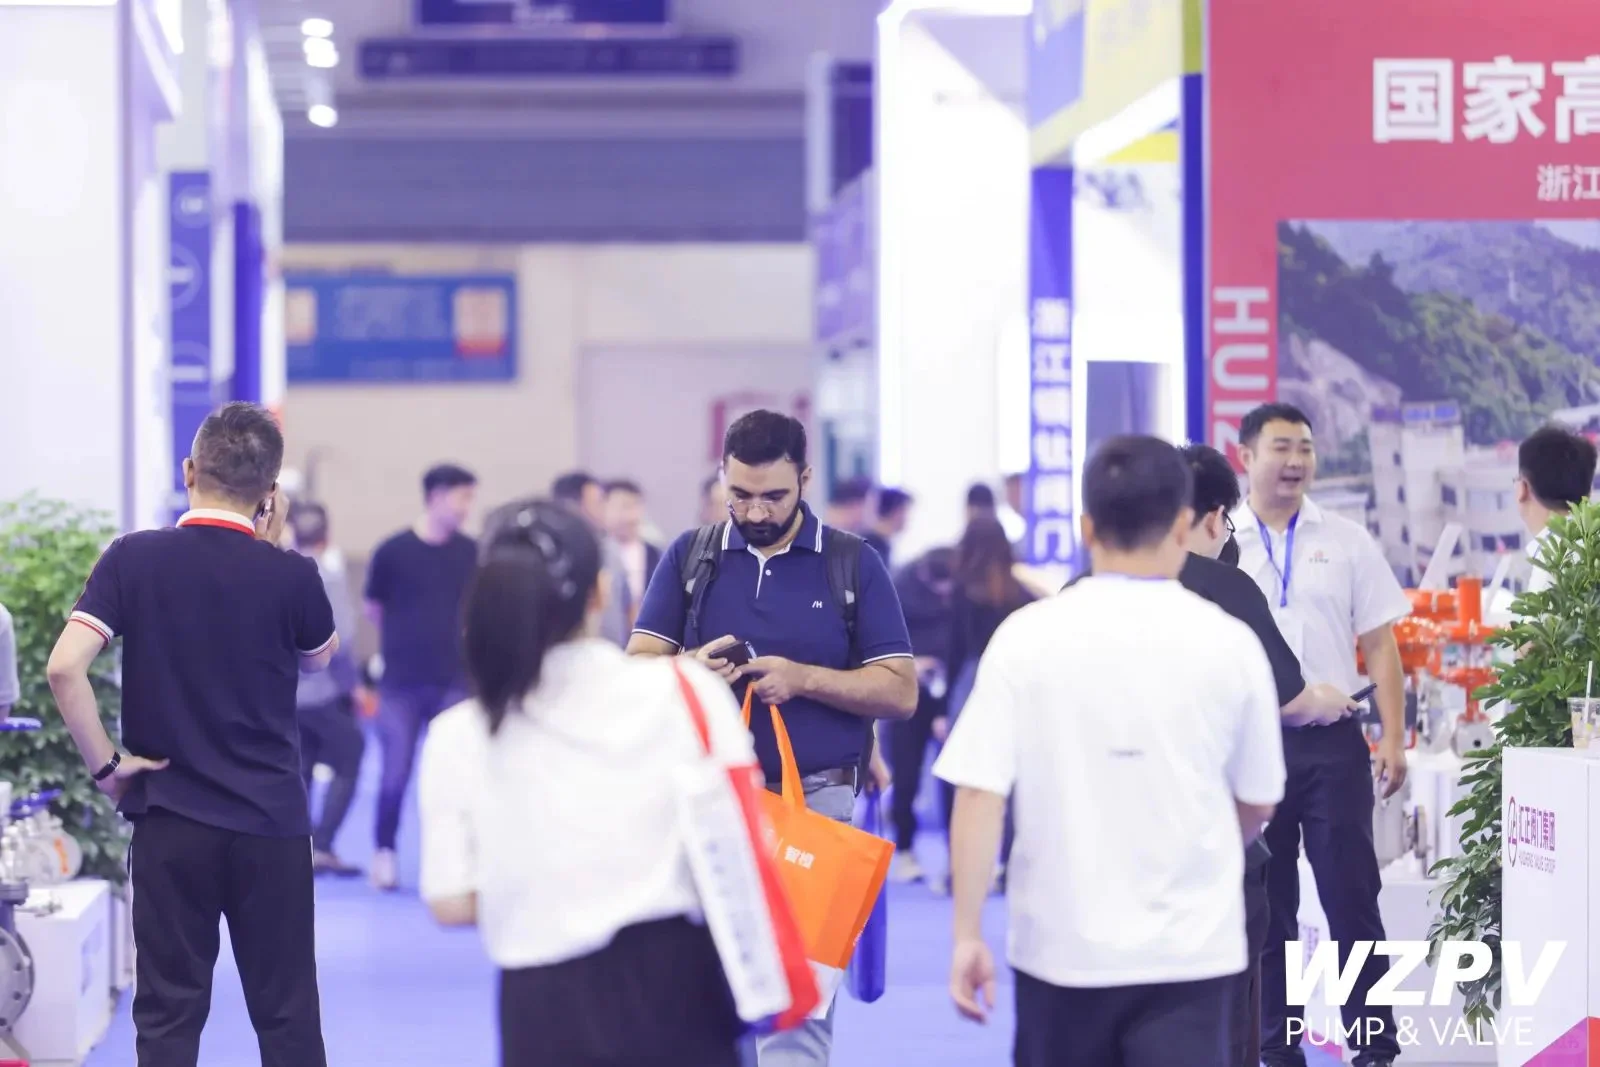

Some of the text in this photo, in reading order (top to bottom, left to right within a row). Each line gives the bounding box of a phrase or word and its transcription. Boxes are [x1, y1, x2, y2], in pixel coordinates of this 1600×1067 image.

[1373, 55, 1600, 143] 国家高
[1537, 163, 1600, 201] 浙江
[1518, 804, 1555, 852] 汇正阀门集团
